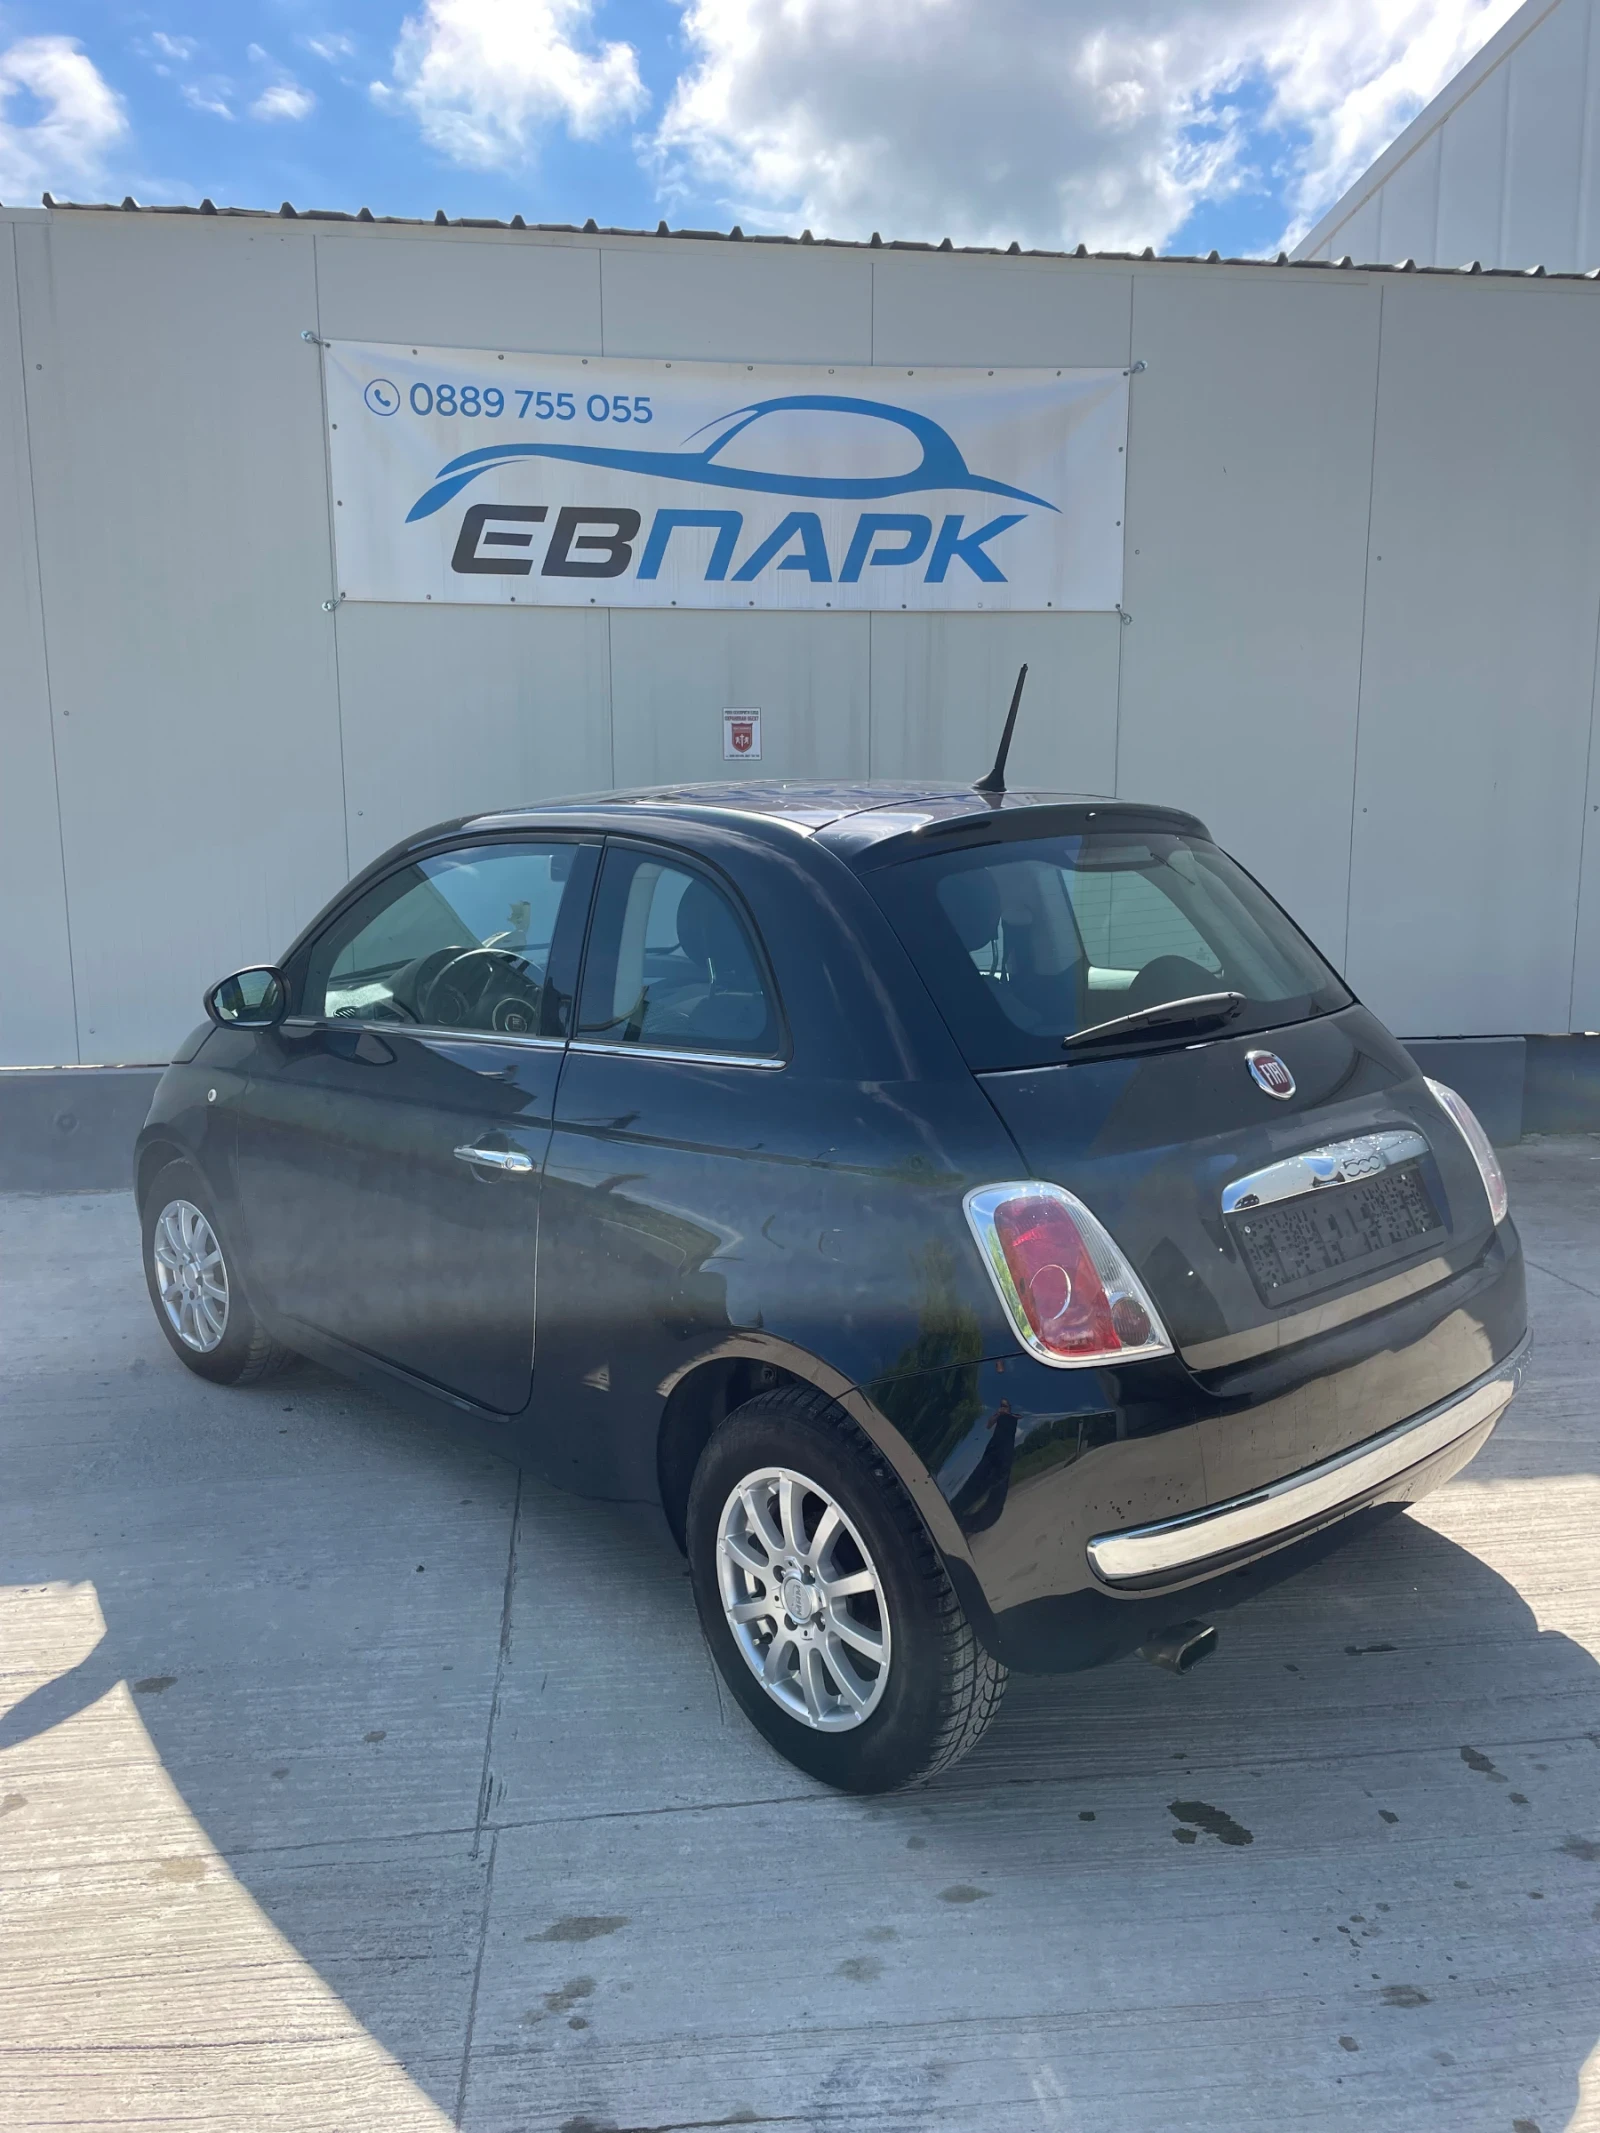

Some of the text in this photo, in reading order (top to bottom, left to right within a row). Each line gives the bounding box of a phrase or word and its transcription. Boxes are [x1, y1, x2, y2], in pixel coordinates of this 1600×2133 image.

[409, 382, 654, 424] 0889 755 055
[450, 503, 1030, 583] ЕВПАРК
[1259, 1062, 1288, 1087] FIAT
[1342, 1155, 1382, 1177] 500
